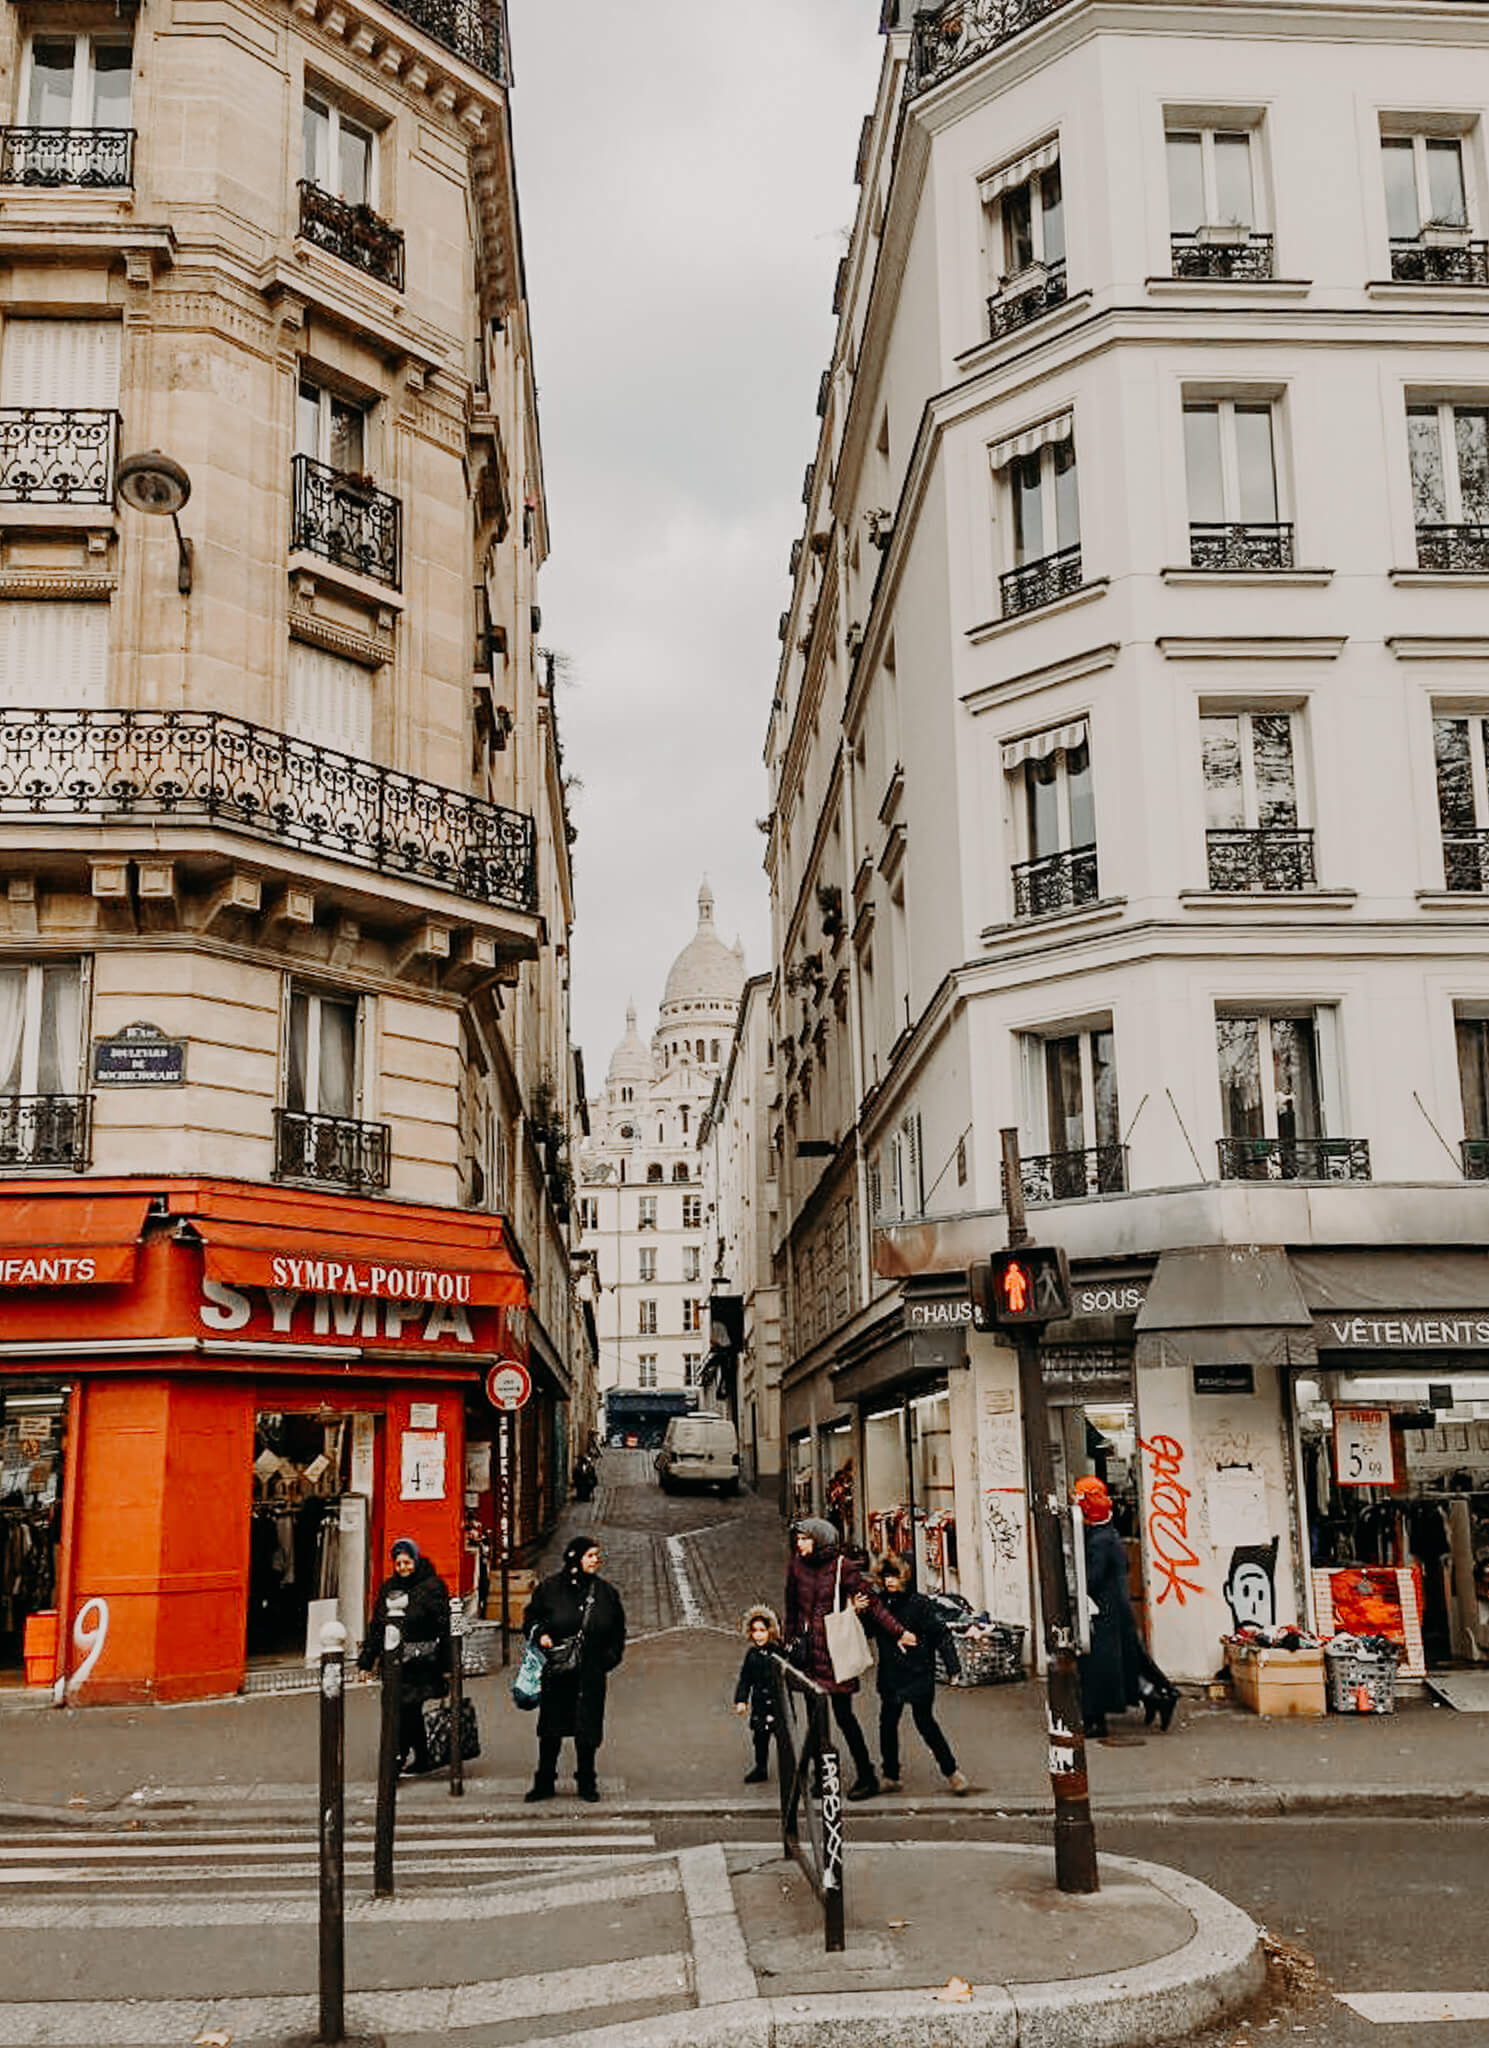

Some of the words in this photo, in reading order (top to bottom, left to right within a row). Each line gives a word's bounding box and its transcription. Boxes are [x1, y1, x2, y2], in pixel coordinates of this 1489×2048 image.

[0, 1259, 96, 1281] FANTS
[272, 1257, 471, 1302] SYMPA-POUTOU
[1331, 1317, 1489, 1344] VÊTEMENTS
